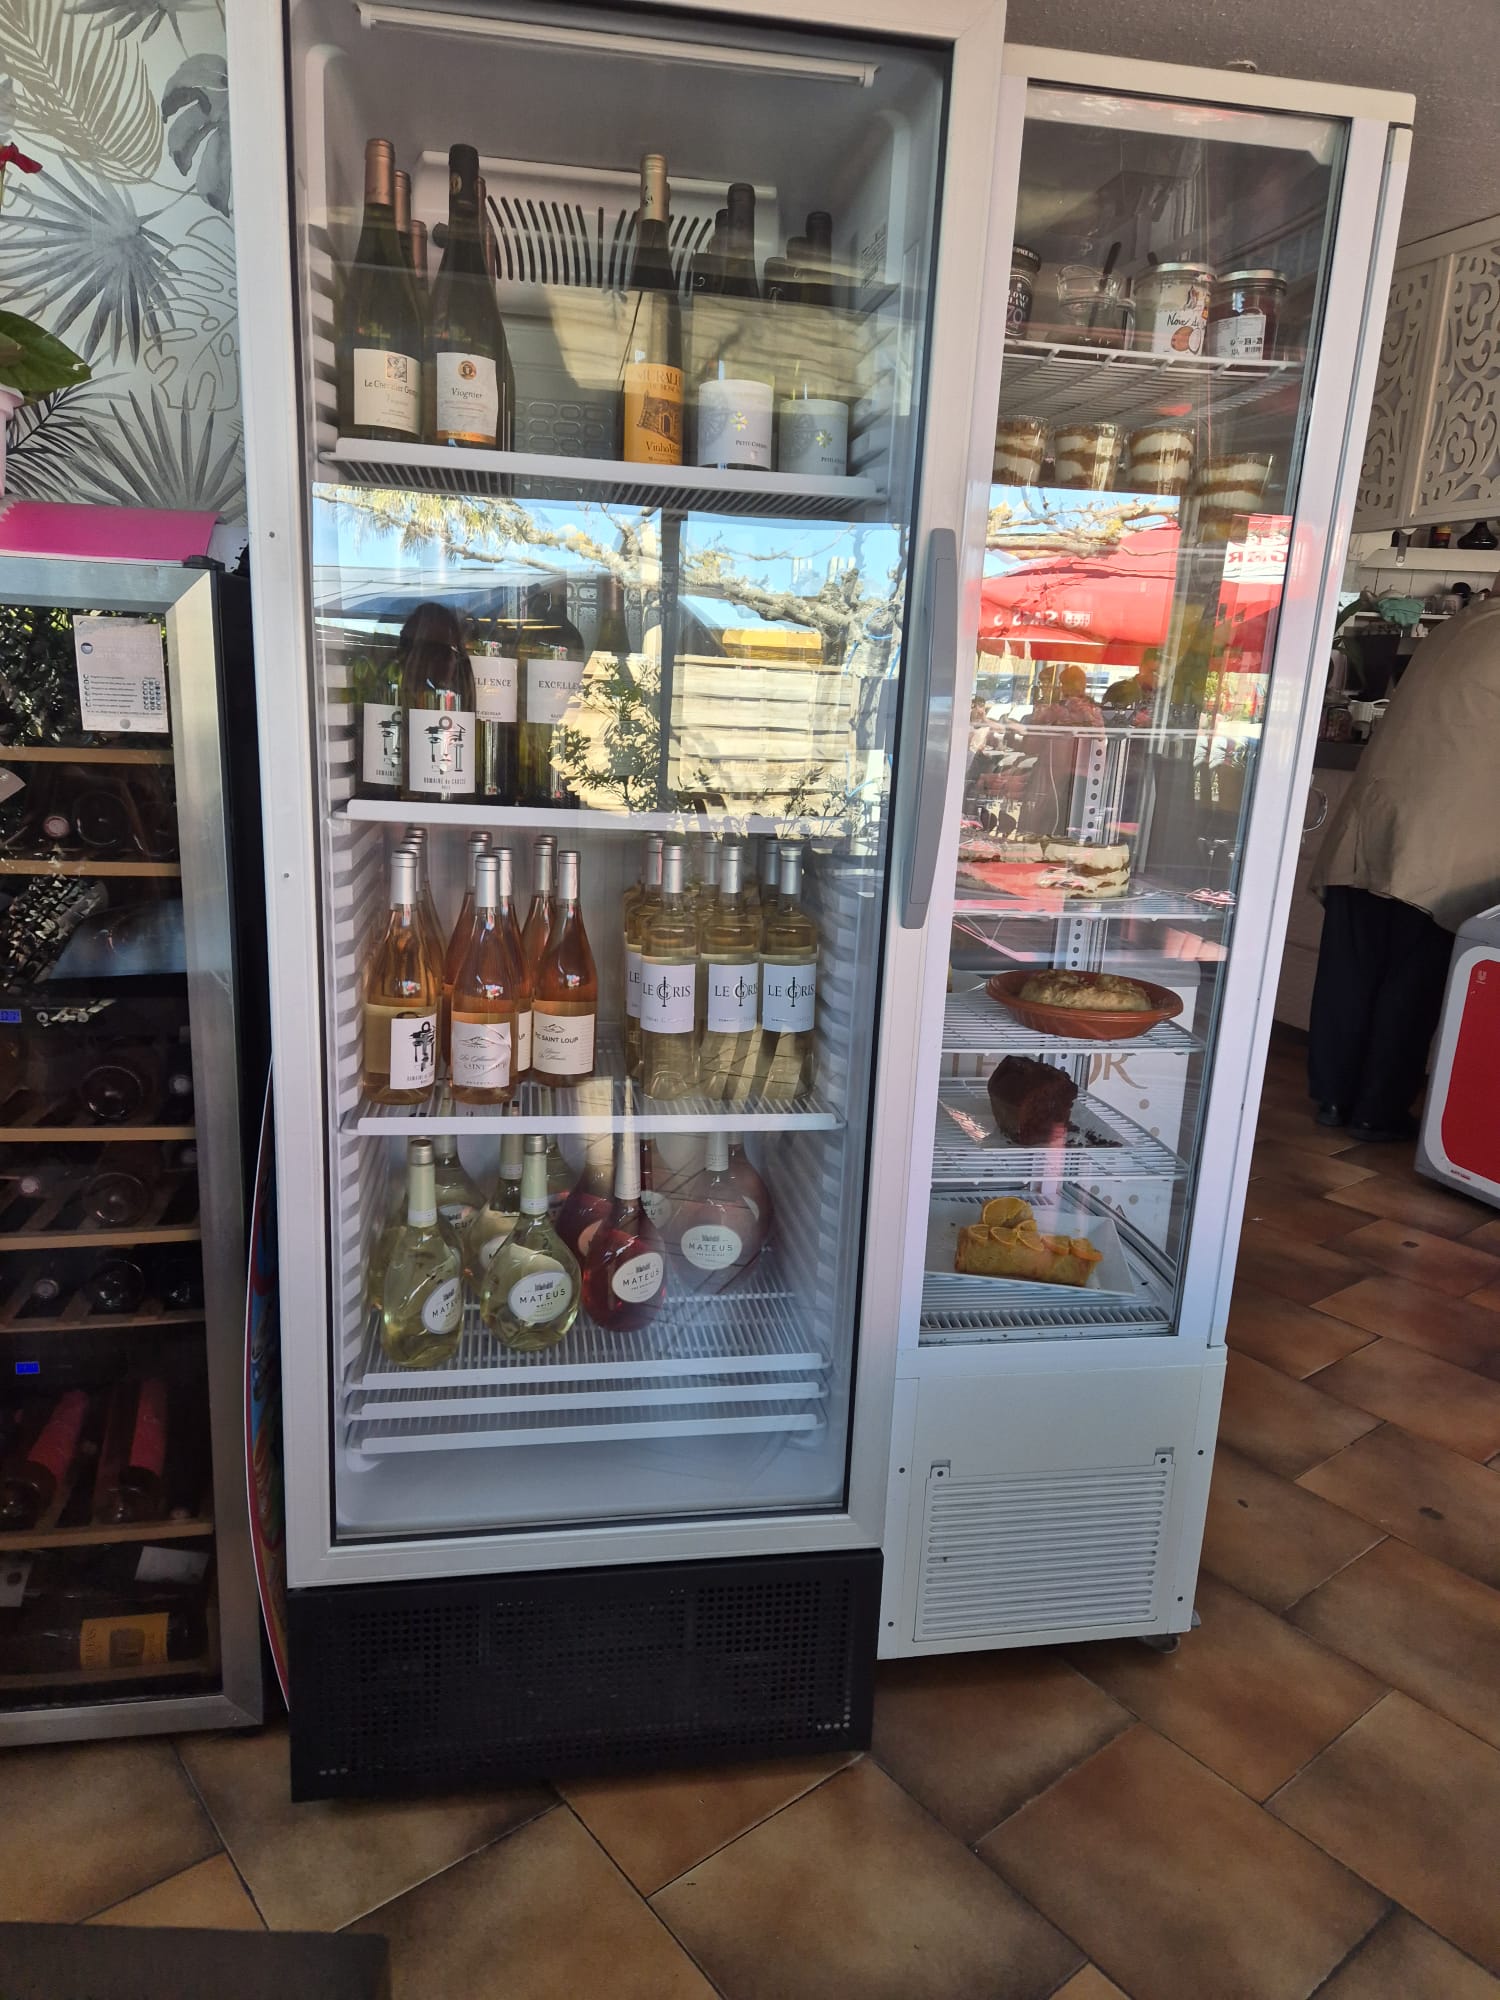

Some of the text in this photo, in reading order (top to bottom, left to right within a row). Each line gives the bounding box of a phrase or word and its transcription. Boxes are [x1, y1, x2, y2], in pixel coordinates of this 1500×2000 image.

[364, 379, 373, 388] Le
[451, 387, 483, 400] Viognier
[642, 983, 691, 1000] LE GRIS
[715, 985, 730, 997] LE
[768, 985, 782, 997] LE
[542, 1034, 560, 1043] SAINT
[561, 1036, 579, 1044] LOUP
[688, 1242, 733, 1252] MATEUS
[622, 1269, 660, 1287] MATEUS
[519, 1288, 566, 1304] MATEUS
